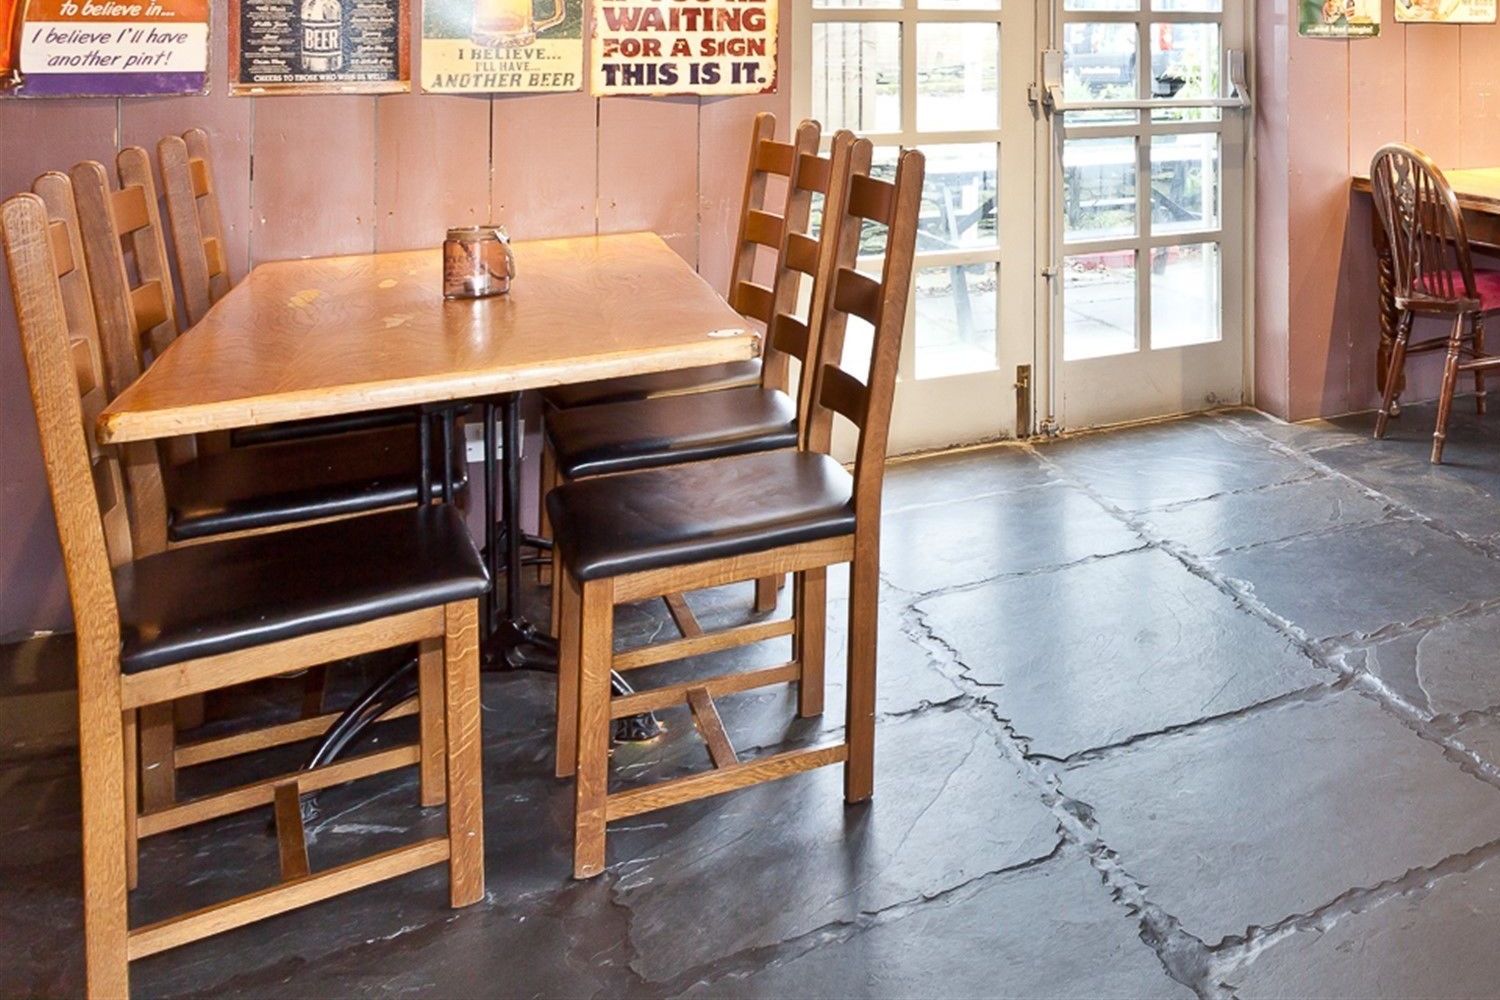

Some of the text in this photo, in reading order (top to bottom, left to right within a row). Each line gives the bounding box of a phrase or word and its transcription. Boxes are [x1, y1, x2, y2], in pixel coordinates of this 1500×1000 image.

[59, 0, 176, 17] to believe in...
[602, 7, 766, 32] WAITING
[32, 27, 188, 44] I believe I'll have
[305, 29, 339, 50] BEER
[458, 48, 464, 60] I
[602, 38, 766, 58] FOR A SIGN
[48, 50, 172, 69] another pint!
[431, 73, 575, 88] ANOTHER BEER
[601, 62, 766, 86] THIS IS IT.
